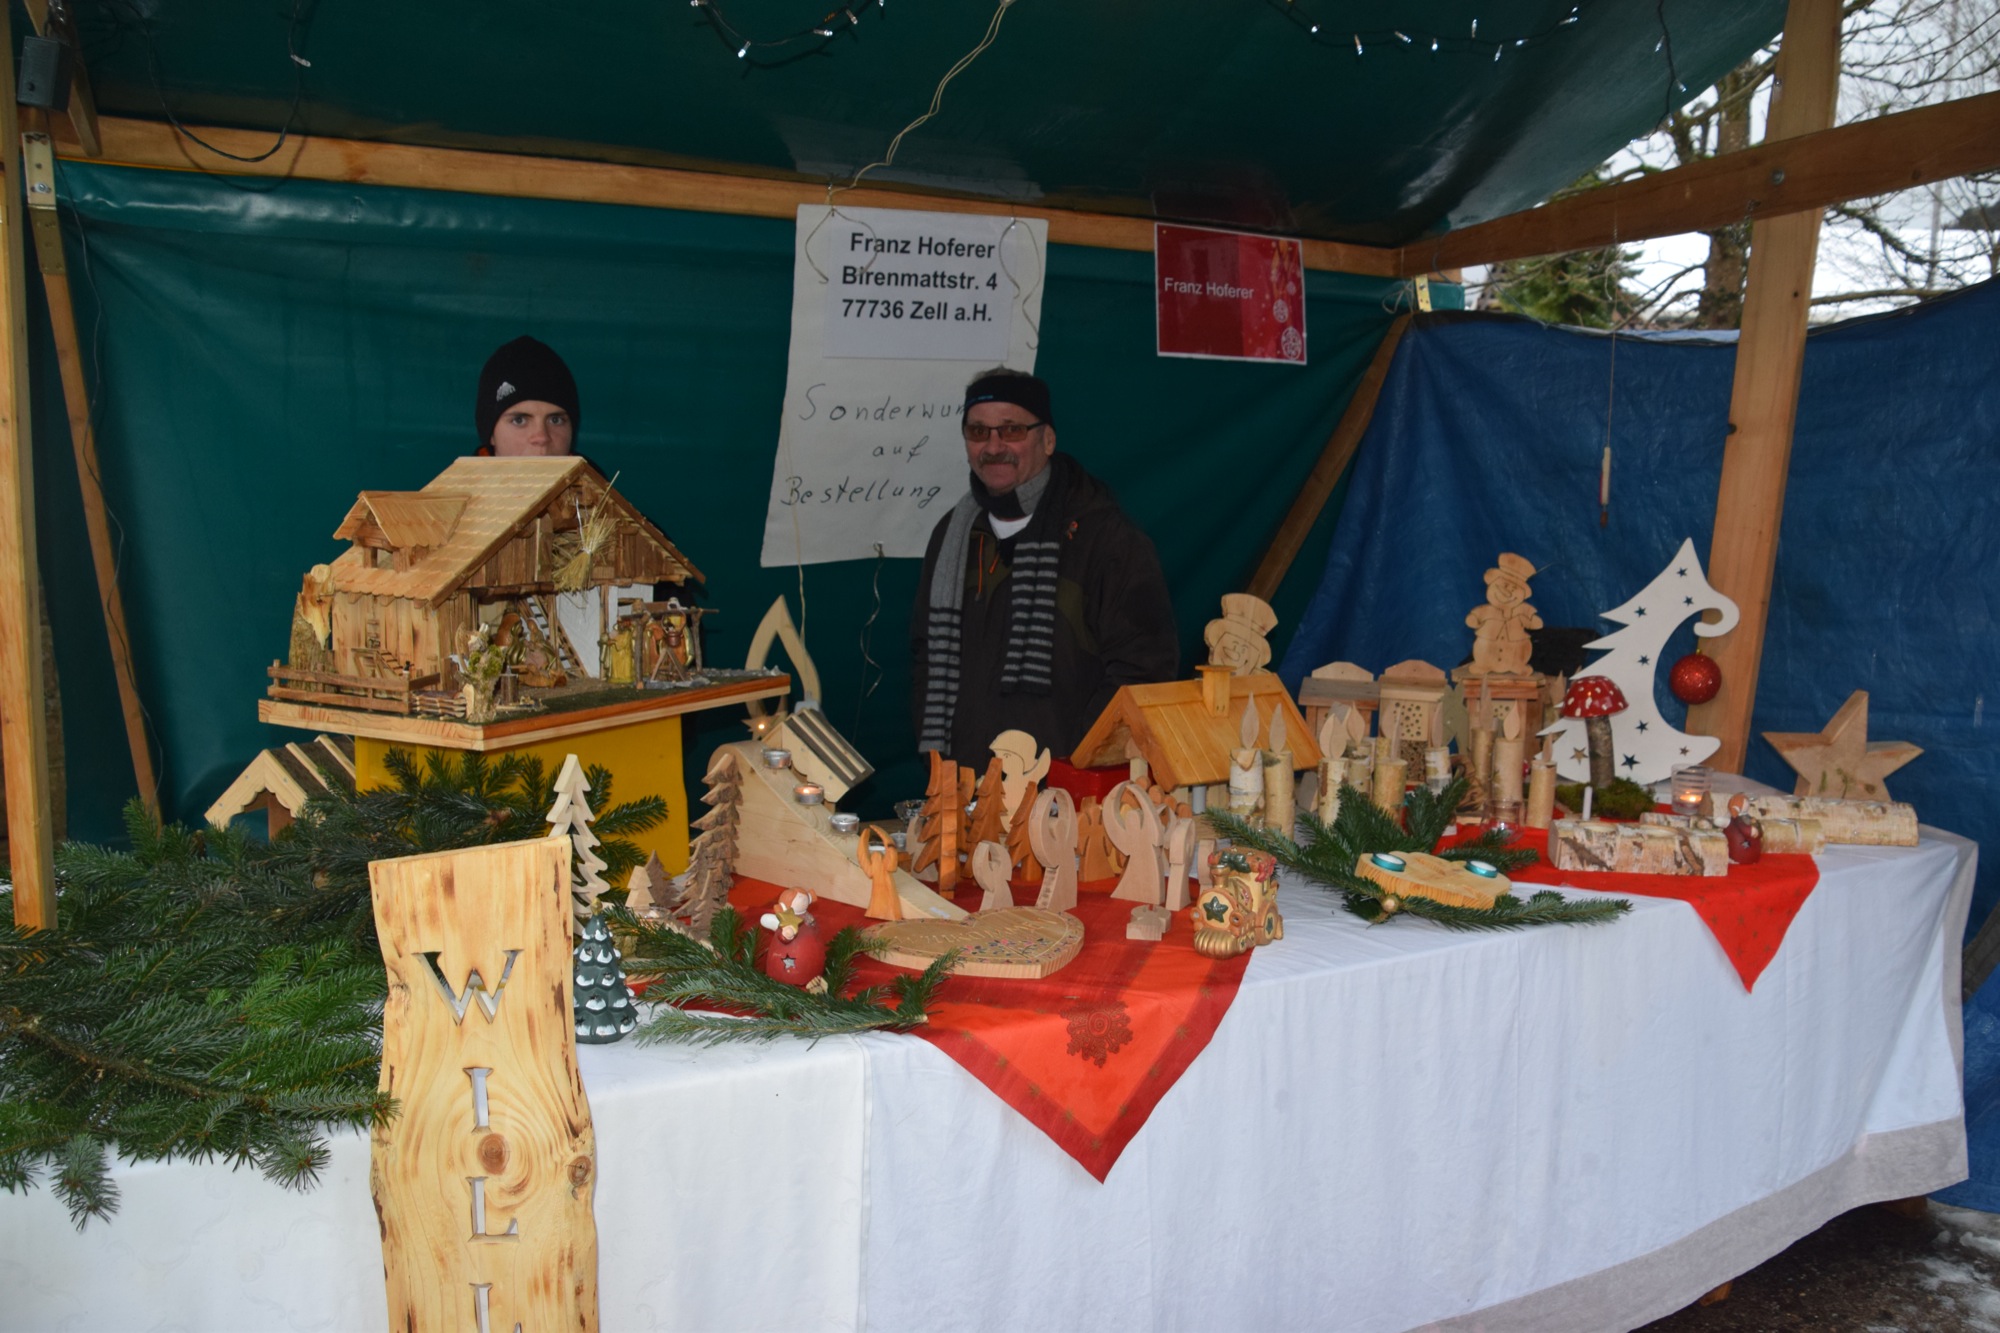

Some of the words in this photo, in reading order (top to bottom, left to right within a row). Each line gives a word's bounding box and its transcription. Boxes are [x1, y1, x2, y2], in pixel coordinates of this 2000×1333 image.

[849, 232, 911, 255] Franz
[917, 235, 996, 259] Hoferer
[841, 265, 980, 290] Birenmattstr.
[986, 271, 998, 290] 4
[1164, 278, 1203, 295] Franz
[1206, 282, 1254, 299] Hoferer
[841, 299, 904, 319] 77736
[909, 300, 948, 321] Zell
[954, 302, 993, 322] a.H.
[873, 435, 929, 462] auf
[781, 475, 942, 508] Bestellung
